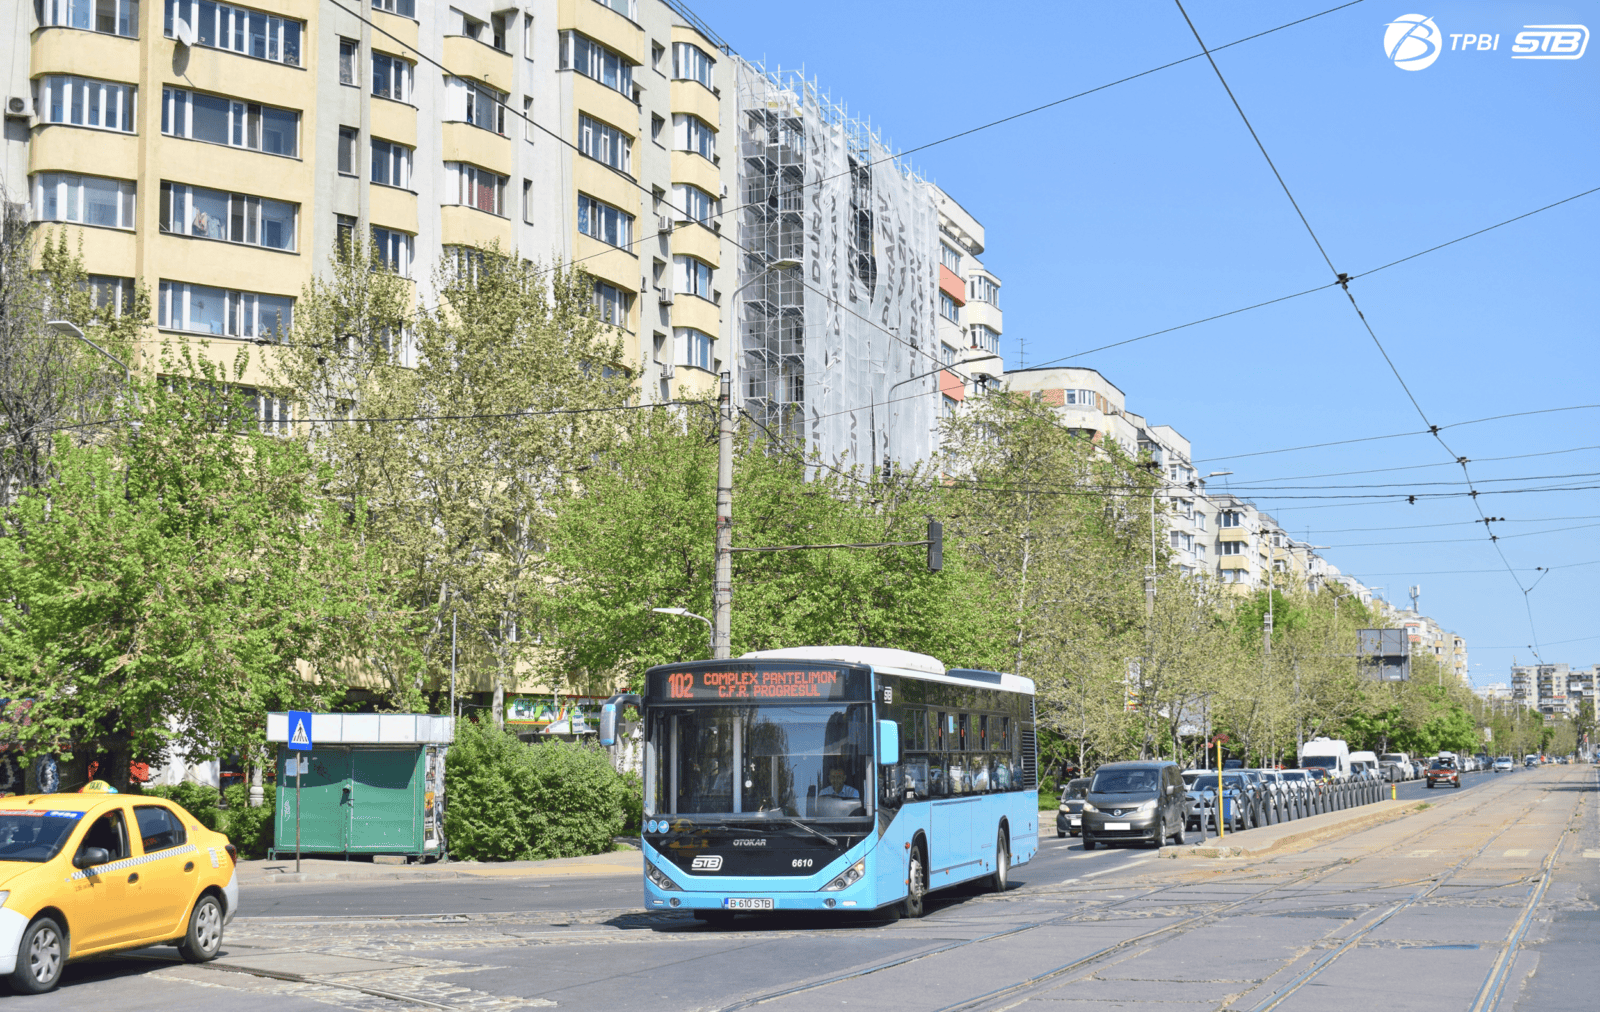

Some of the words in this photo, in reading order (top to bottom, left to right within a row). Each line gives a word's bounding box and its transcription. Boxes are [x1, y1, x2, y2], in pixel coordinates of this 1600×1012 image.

[704, 672, 759, 685] COMPLEX
[762, 671, 837, 684] PANTELIMON
[668, 672, 694, 698] 102
[718, 685, 750, 698] C.F.R.
[753, 684, 820, 697] PROGRESUL
[691, 857, 721, 869] STB
[792, 859, 813, 868] 6610
[730, 900, 736, 908] B
[739, 900, 751, 908] 610
[754, 900, 771, 908] STB
